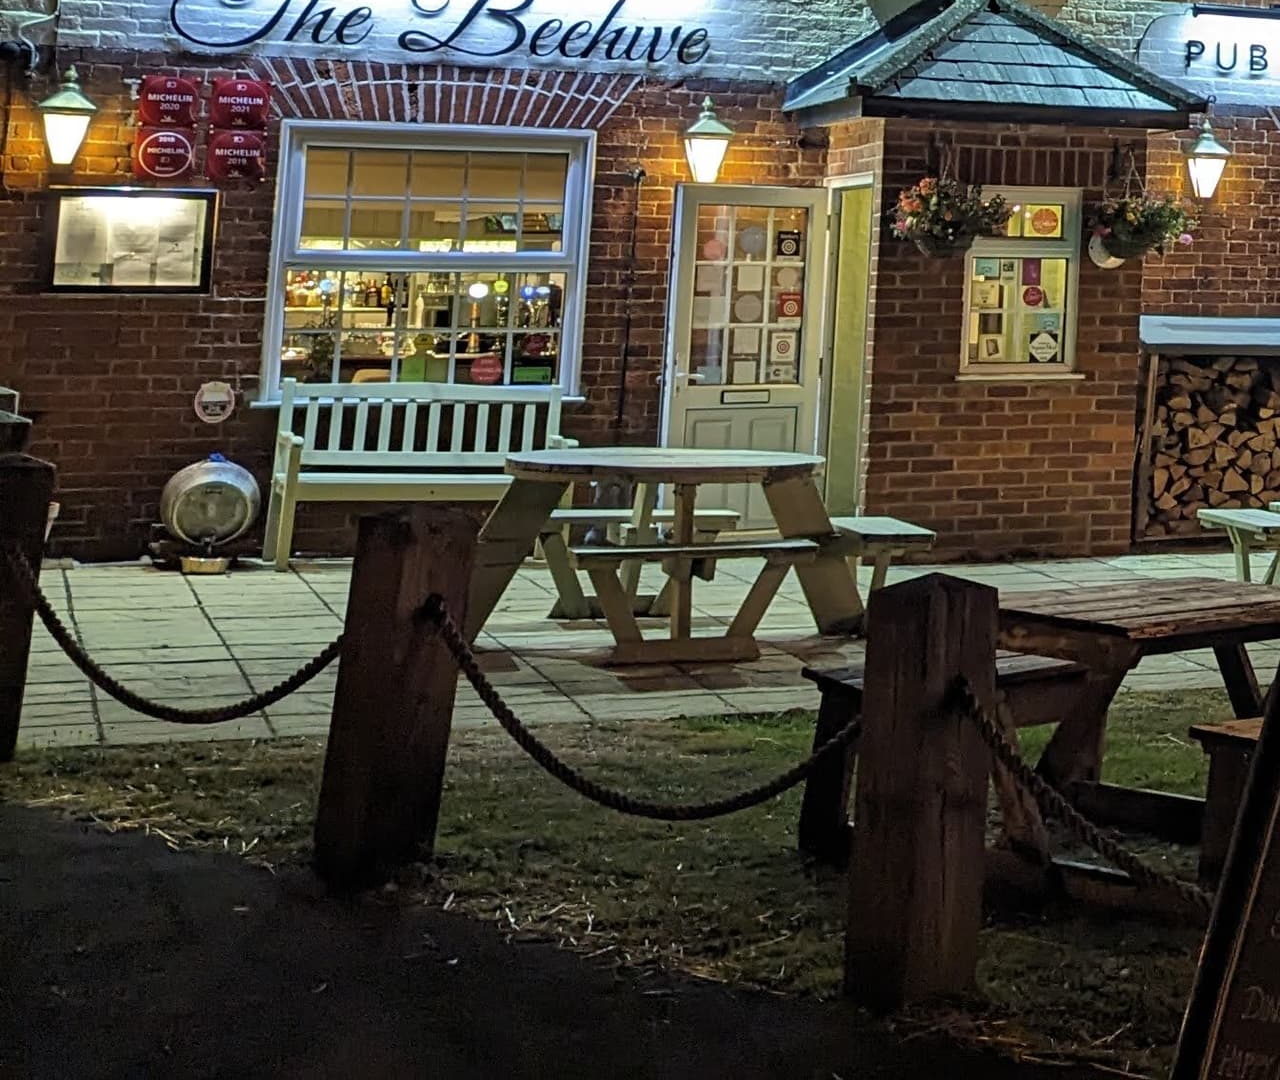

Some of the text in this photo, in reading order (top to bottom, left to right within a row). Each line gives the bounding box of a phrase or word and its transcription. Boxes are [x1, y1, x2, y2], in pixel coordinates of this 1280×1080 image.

[1184, 39, 1268, 77] PUB
[148, 93, 193, 103] MICHELIN
[218, 95, 263, 106] MICHELIN
[159, 102, 180, 110] 2020
[230, 104, 250, 113] 2021
[147, 147, 185, 155] MICHELIN
[215, 148, 260, 157] MICHELIN
